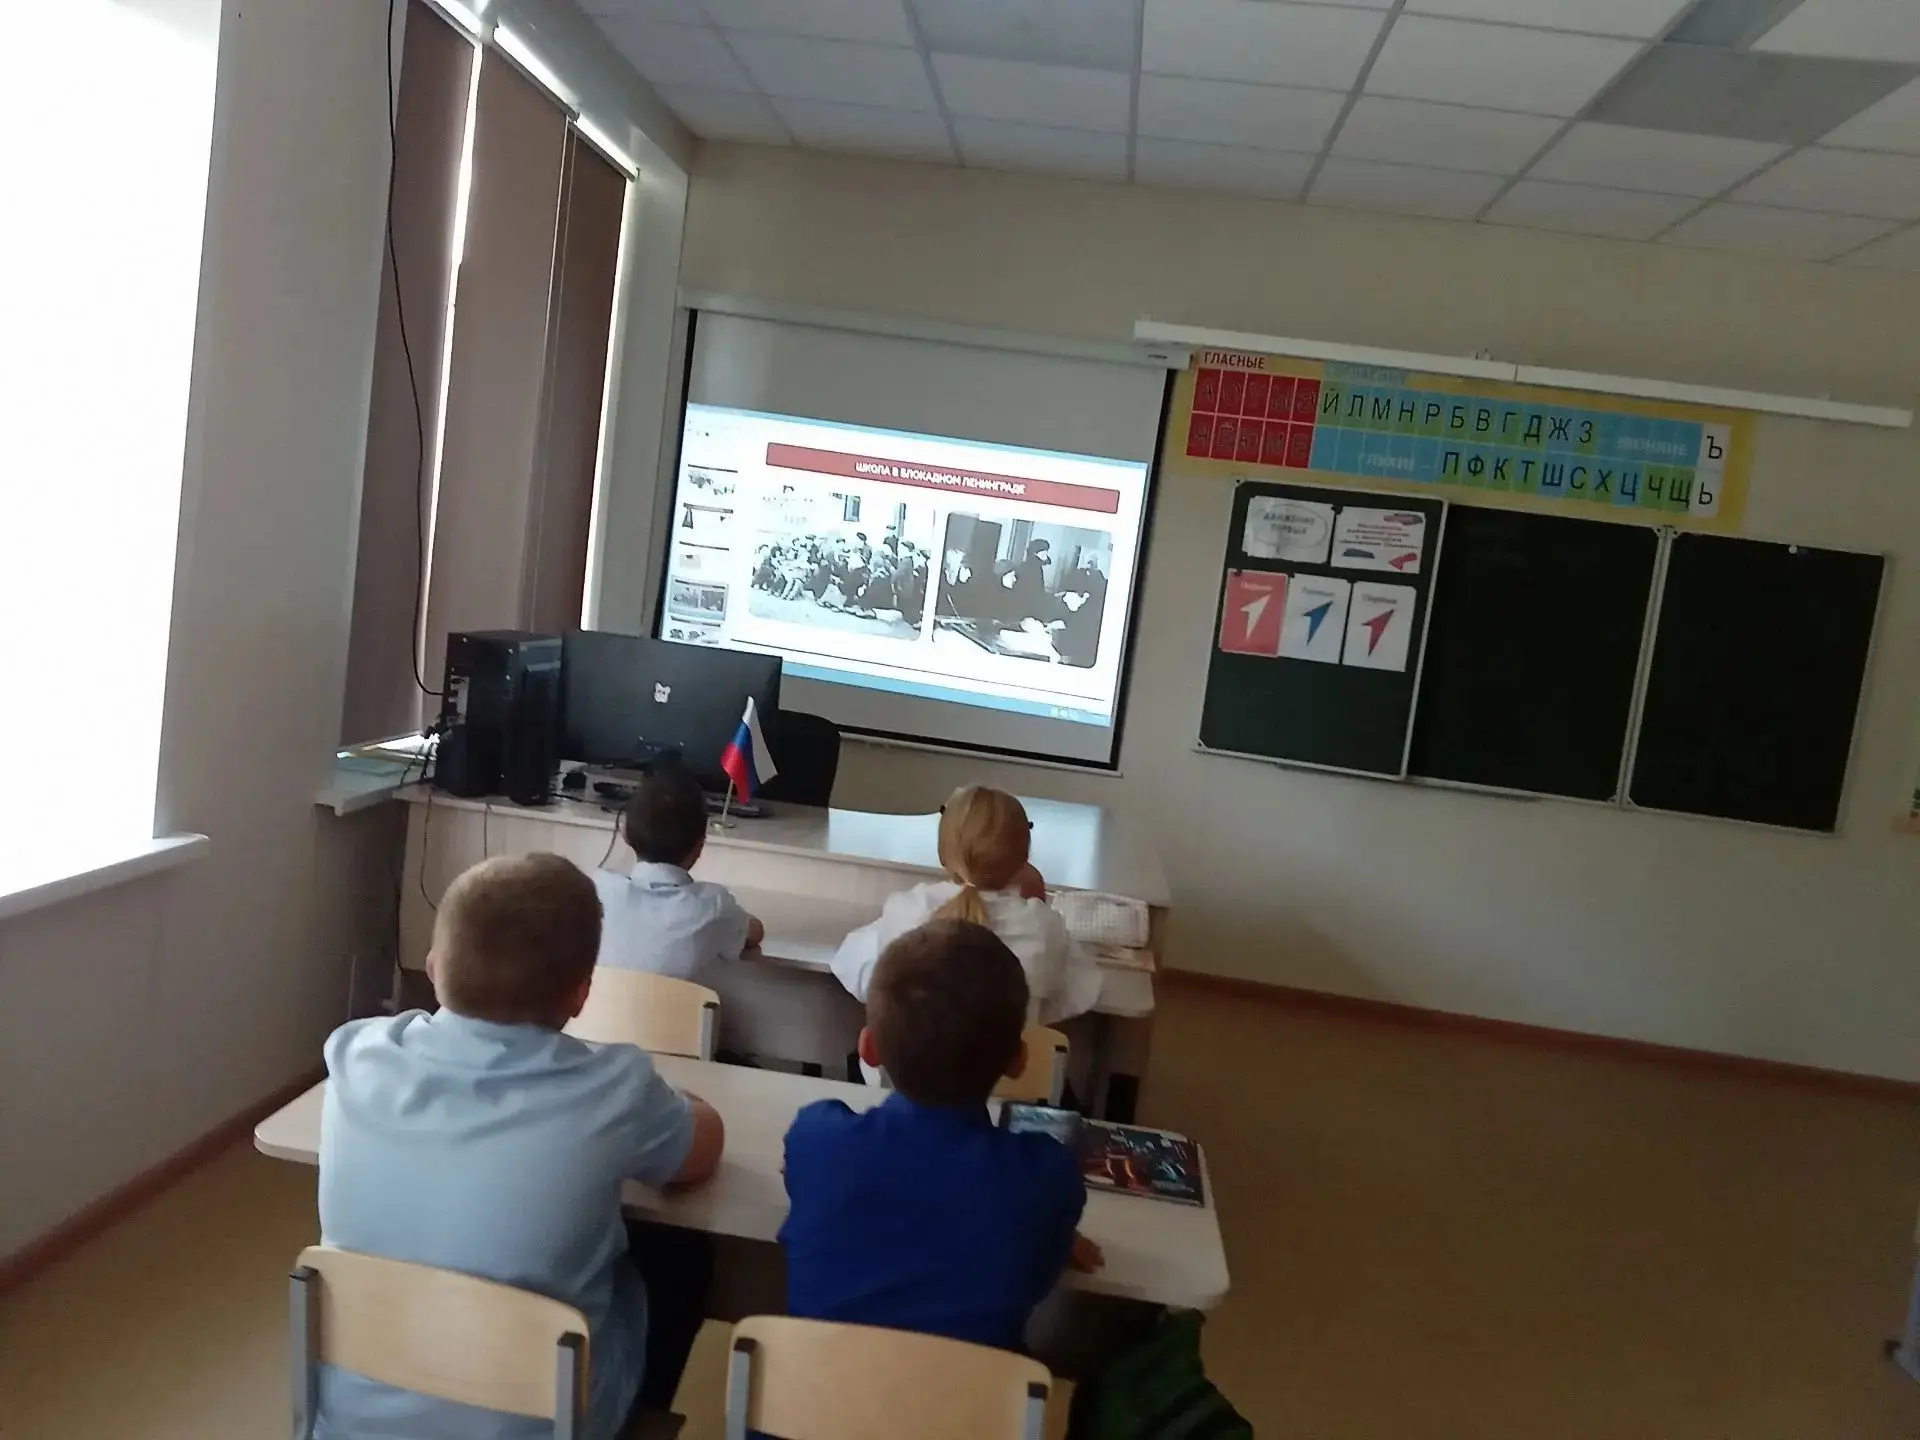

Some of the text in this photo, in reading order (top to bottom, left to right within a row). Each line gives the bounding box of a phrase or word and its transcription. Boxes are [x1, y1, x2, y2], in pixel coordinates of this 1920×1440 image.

[1204, 351, 1265, 369] ГЛАСНЫЕ
[1322, 388, 1340, 415] Й
[1348, 394, 1364, 418] Л
[1371, 397, 1391, 420] М
[1398, 400, 1415, 422] Н
[1424, 402, 1441, 425] Р
[1450, 405, 1465, 429] Б
[1475, 408, 1491, 432] В
[1501, 411, 1517, 433] Г
[1523, 414, 1542, 444] Д
[1548, 416, 1572, 442] Ж
[1578, 420, 1594, 443] З
[1706, 434, 1723, 460] Ъ
[855, 460, 1026, 495] ШКОЛА В БЛОКАДНОМ ЛЕНИНГРАДЕ
[1442, 451, 1460, 476] П
[1467, 454, 1485, 477] Ф
[1493, 457, 1509, 481] К
[1521, 460, 1536, 484] Т
[1541, 462, 1564, 487] Ш
[1570, 466, 1587, 490] С
[1594, 468, 1612, 493] Х
[1620, 472, 1638, 502] Ц
[1648, 474, 1664, 499] Ч
[1669, 477, 1691, 509] Щ
[1698, 482, 1713, 505] Ь
